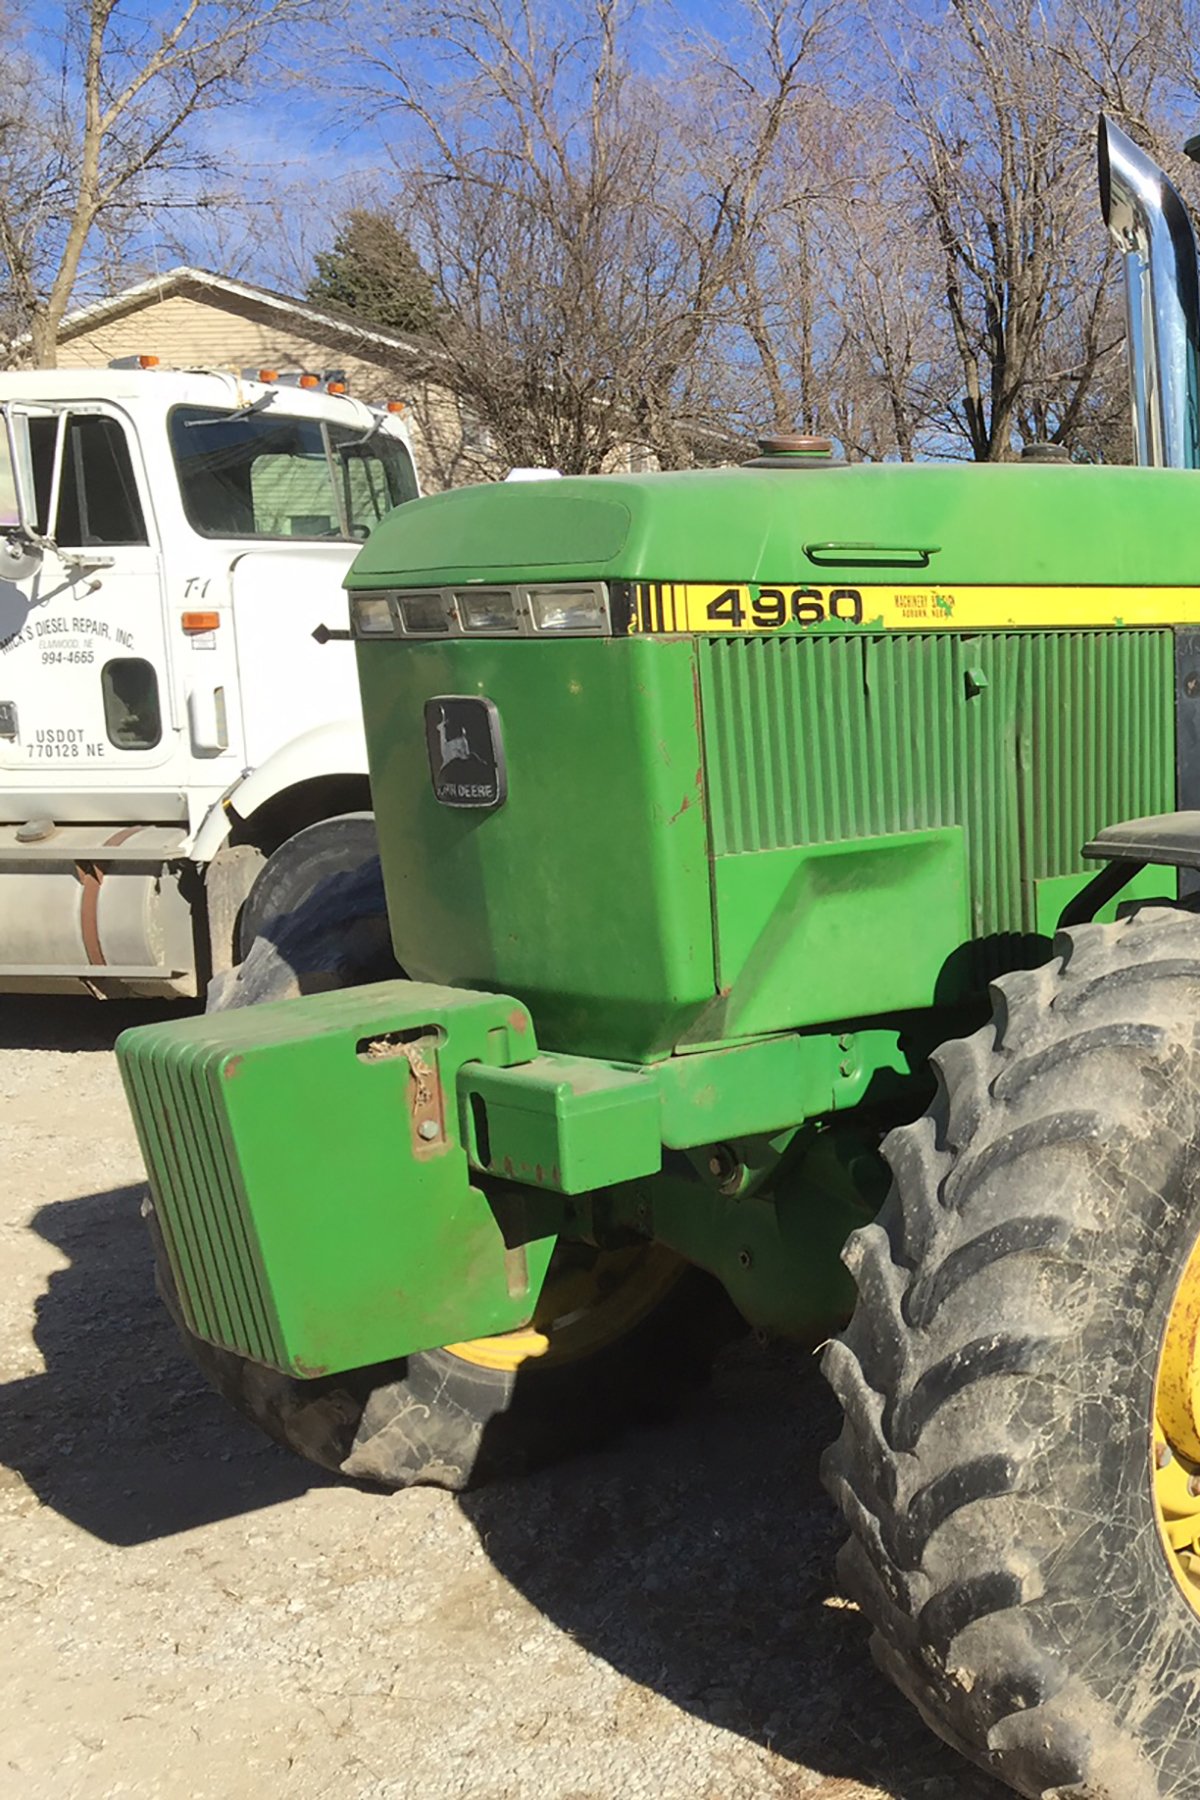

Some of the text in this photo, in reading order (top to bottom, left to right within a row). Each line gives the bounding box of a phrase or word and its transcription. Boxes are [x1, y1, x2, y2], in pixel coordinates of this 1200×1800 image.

[706, 589, 863, 627] 4960
[35, 618, 69, 637] DIESEL
[41, 651, 94, 664] 994-4665
[36, 729, 84, 743] USDOT
[27, 744, 104, 758] 770128 NE
[458, 784, 493, 798] DEERE
